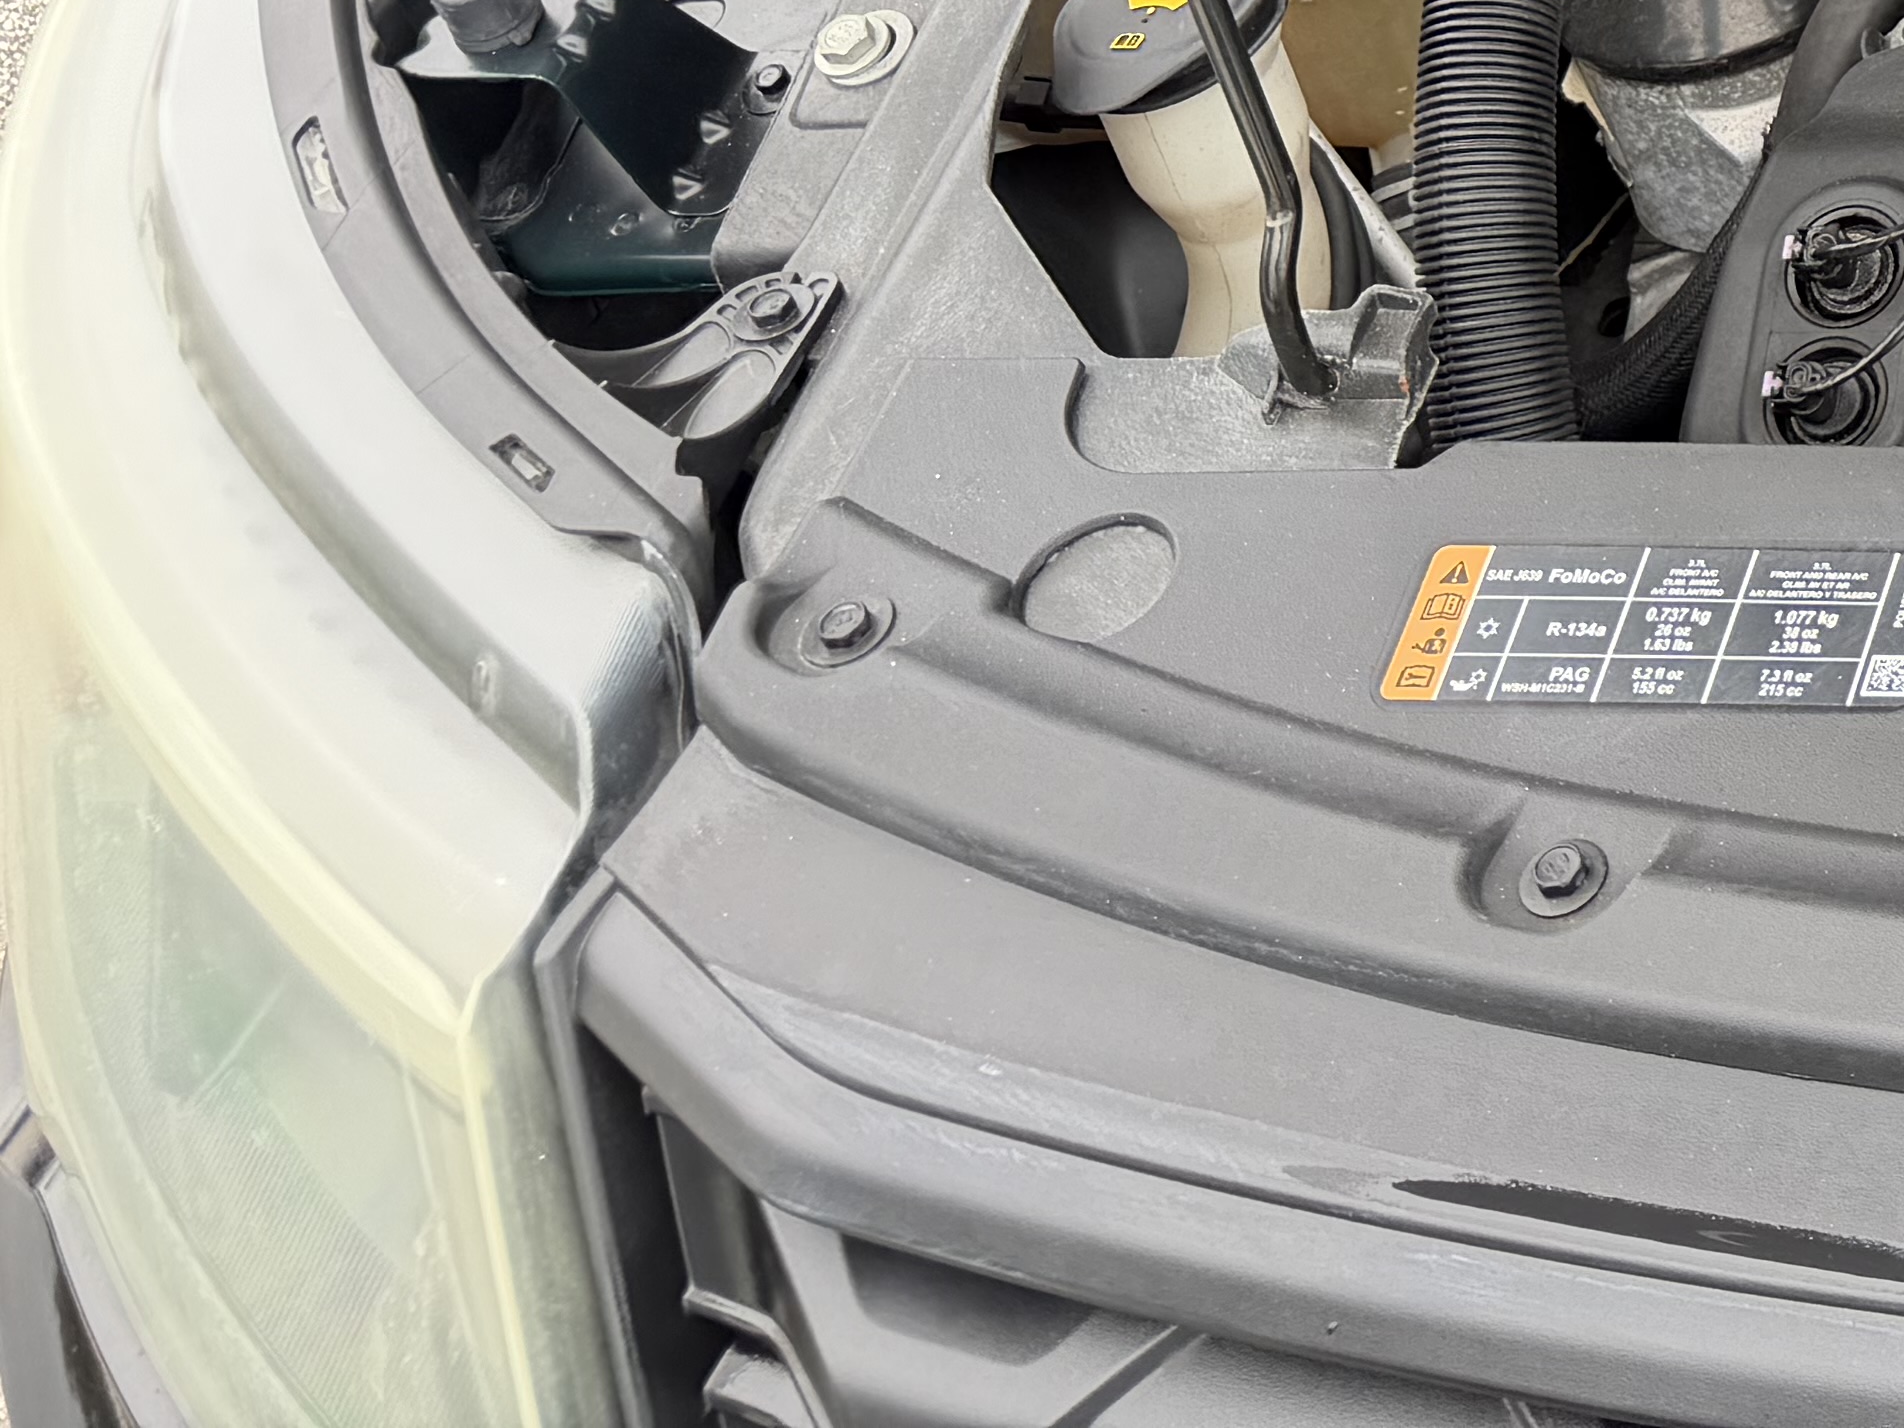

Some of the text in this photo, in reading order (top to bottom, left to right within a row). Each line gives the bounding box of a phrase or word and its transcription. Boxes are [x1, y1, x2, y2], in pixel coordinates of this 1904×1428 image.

[1486, 568, 1627, 585] SAE J639 FoMoCo
[1645, 607, 1712, 627] 0.737 kg
[1774, 610, 1840, 629] 1.077 kg
[1545, 622, 1607, 638] R-134a
[1654, 624, 1692, 637] 26 oz
[1801, 628, 1820, 640] oz
[1671, 638, 1694, 652] lbs
[1799, 641, 1823, 654] lbs
[1548, 666, 1591, 683] PAG
[1631, 667, 1653, 680] 5.2
[1665, 668, 1685, 680] oz
[1794, 671, 1814, 683] oz
[1631, 681, 1676, 695] 155 cc
[1758, 684, 1804, 697] 215 cc
